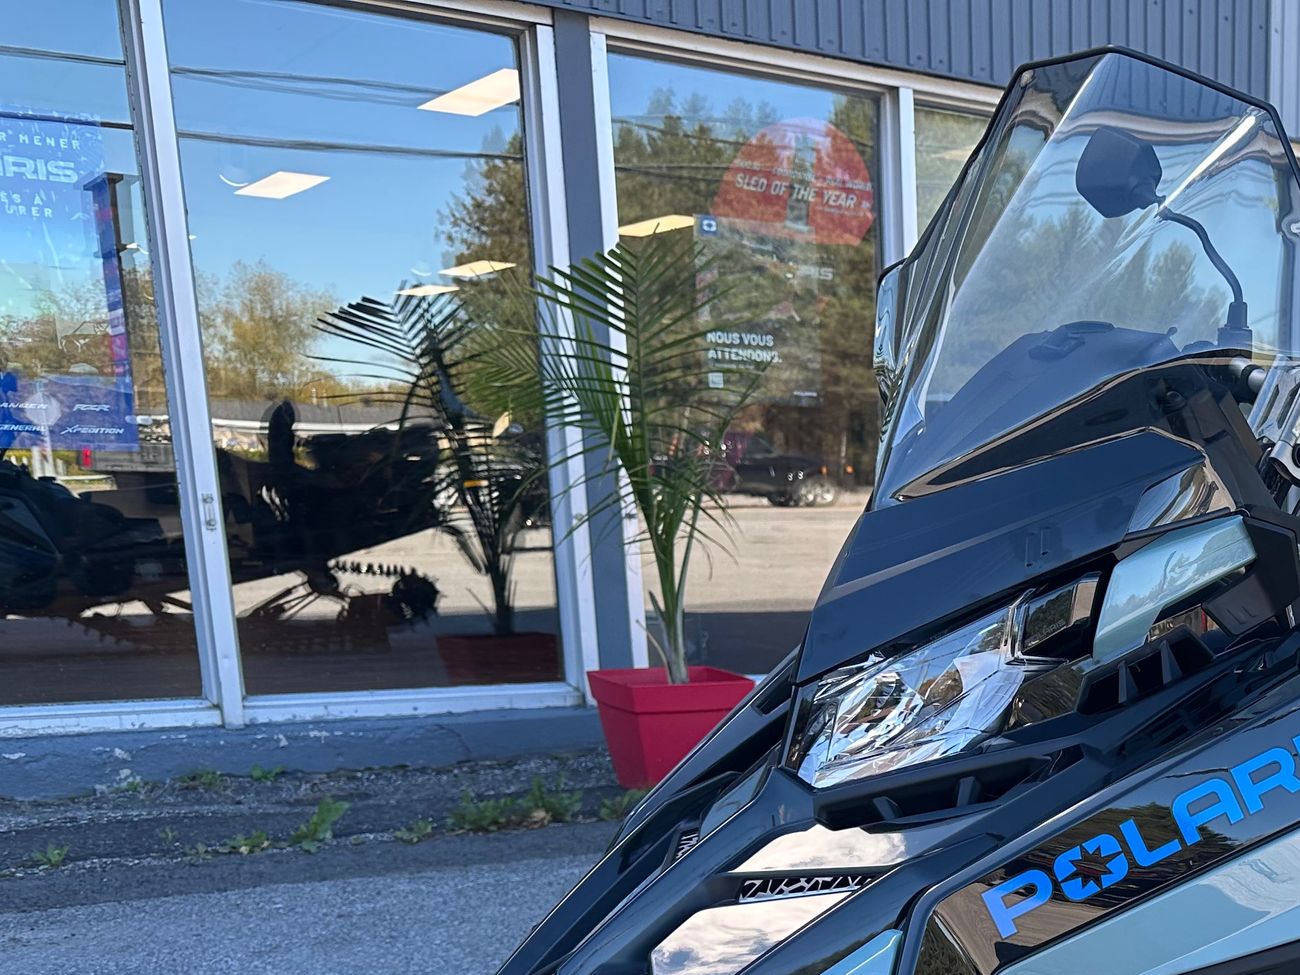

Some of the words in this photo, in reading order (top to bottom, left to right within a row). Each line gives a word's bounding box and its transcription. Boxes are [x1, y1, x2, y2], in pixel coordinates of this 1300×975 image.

[19, 133, 80, 150] MENER
[0, 155, 79, 184] RIS
[735, 173, 767, 193] SLED
[770, 180, 789, 196] OF
[792, 184, 818, 202] THE
[823, 190, 857, 209] YEAR
[706, 331, 740, 345] NOUS
[741, 333, 774, 347] VOUS
[61, 425, 124, 434] XPEDITION
